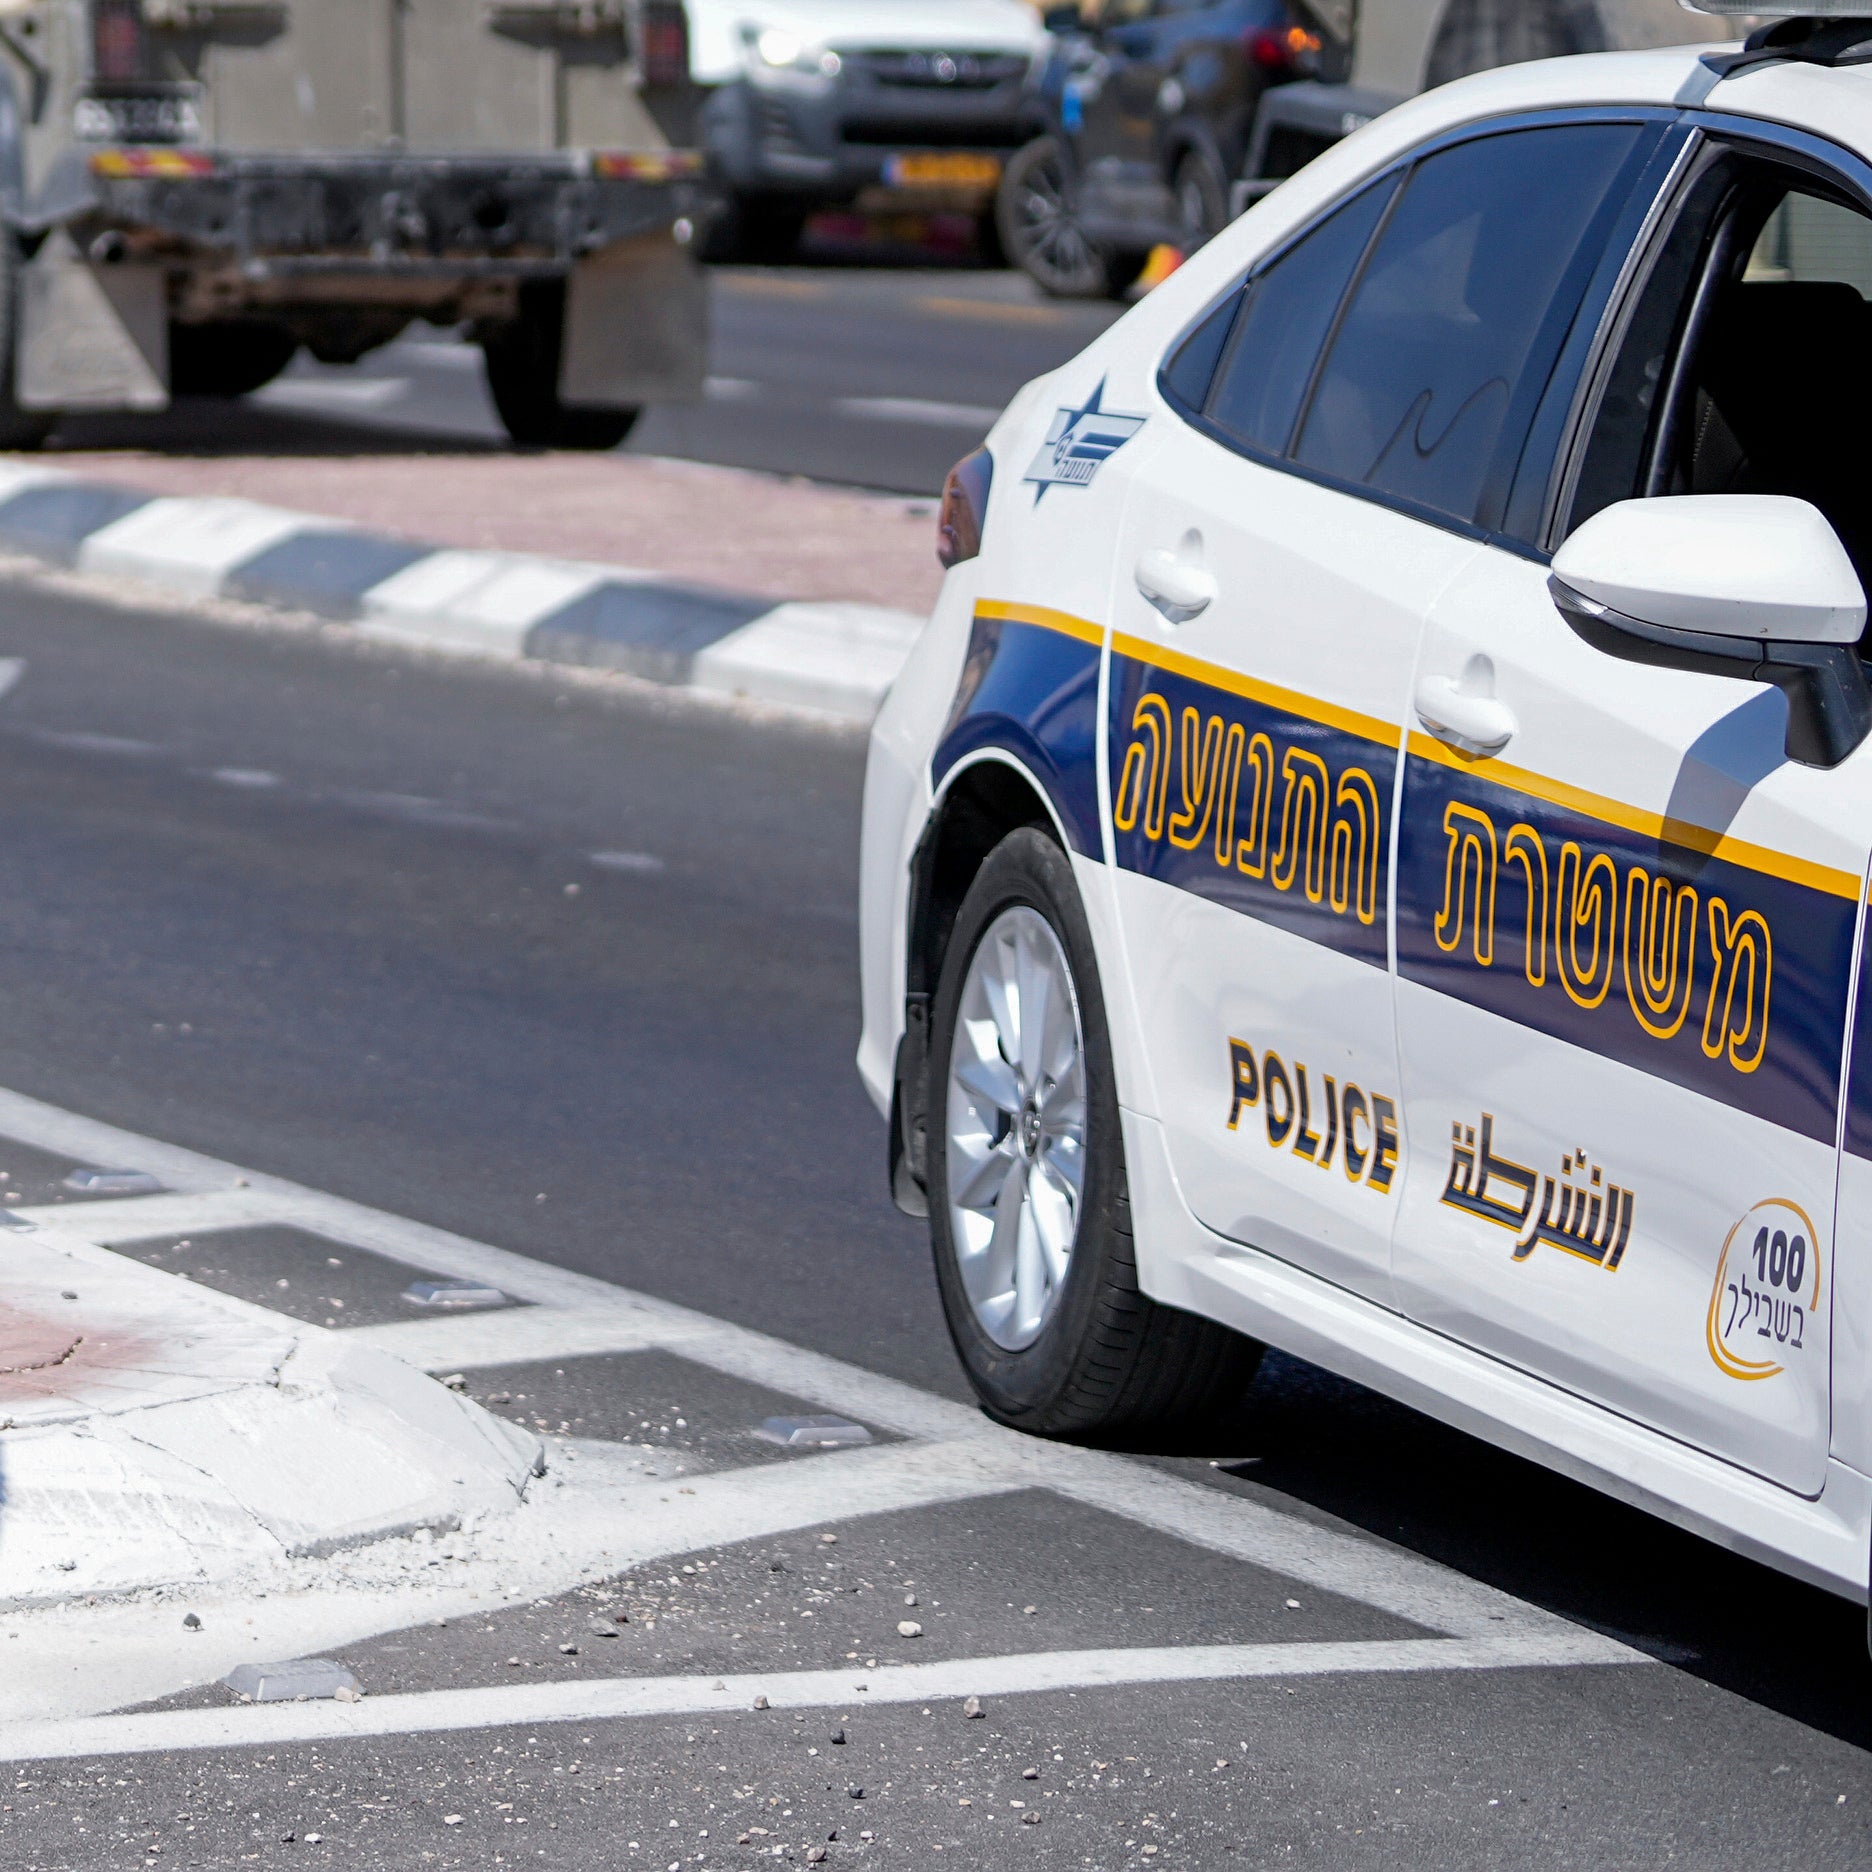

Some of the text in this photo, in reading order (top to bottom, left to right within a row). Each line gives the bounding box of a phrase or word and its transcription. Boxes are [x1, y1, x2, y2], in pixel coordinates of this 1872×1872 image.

[1114, 692, 1772, 1073] משטרת התנועה
[1226, 1035, 1400, 1195] POLICE
[1439, 1112, 1635, 1273] الشرطة
[1724, 1273, 1805, 1349] בשבילך
[1752, 1225, 1806, 1293] 100
